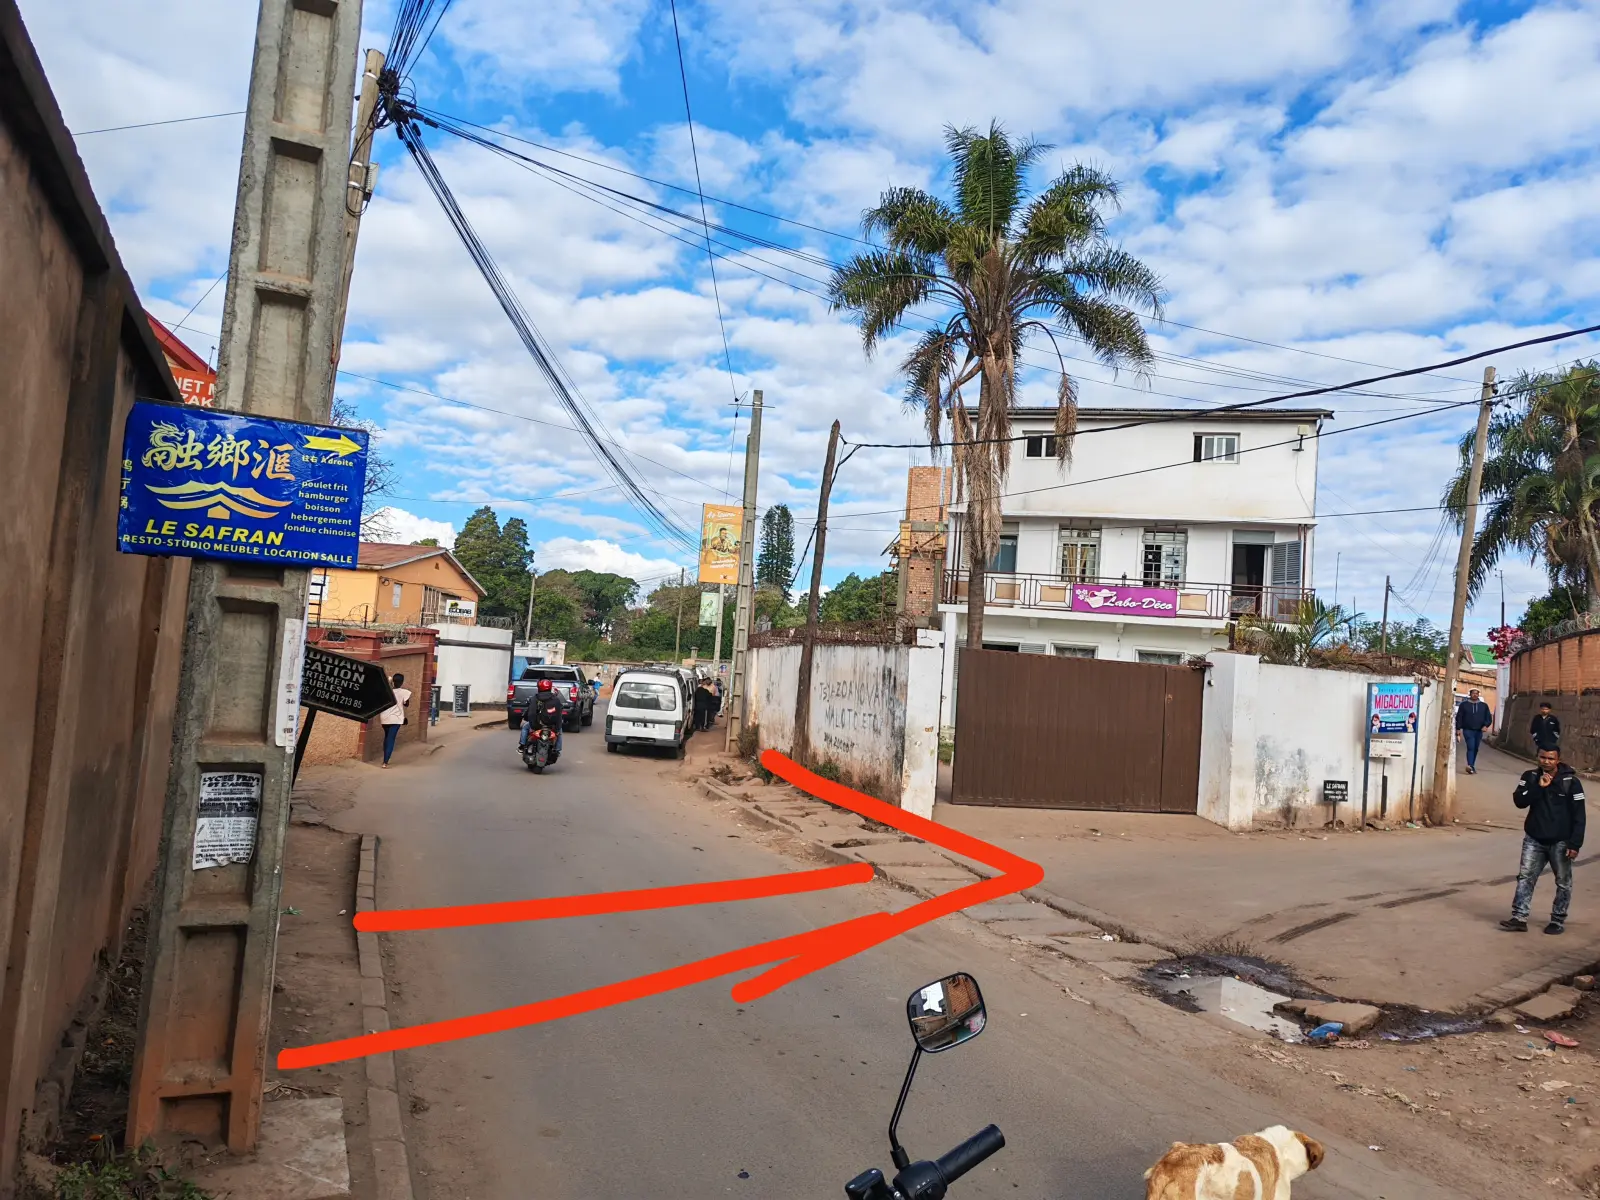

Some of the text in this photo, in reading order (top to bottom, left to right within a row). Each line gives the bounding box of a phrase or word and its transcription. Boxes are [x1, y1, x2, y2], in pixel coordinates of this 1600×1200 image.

[328, 457, 354, 467] droite
[301, 481, 349, 492] poulet frit
[298, 490, 350, 504] hamburger
[305, 502, 341, 513] boisson
[290, 512, 353, 526] hebergement
[145, 519, 285, 546] LE SAFRAN
[284, 523, 357, 538] fondue chinoise
[213, 543, 260, 556] MEUBLE
[264, 547, 318, 561] LOCATION
[320, 553, 353, 564] SALLE
[302, 669, 361, 691] RTEMENTS
[316, 689, 330, 700] 034
[330, 693, 340, 703] 41
[340, 695, 353, 706] 213
[353, 699, 363, 709] 85
[1374, 694, 1415, 710] MIGACHOU
